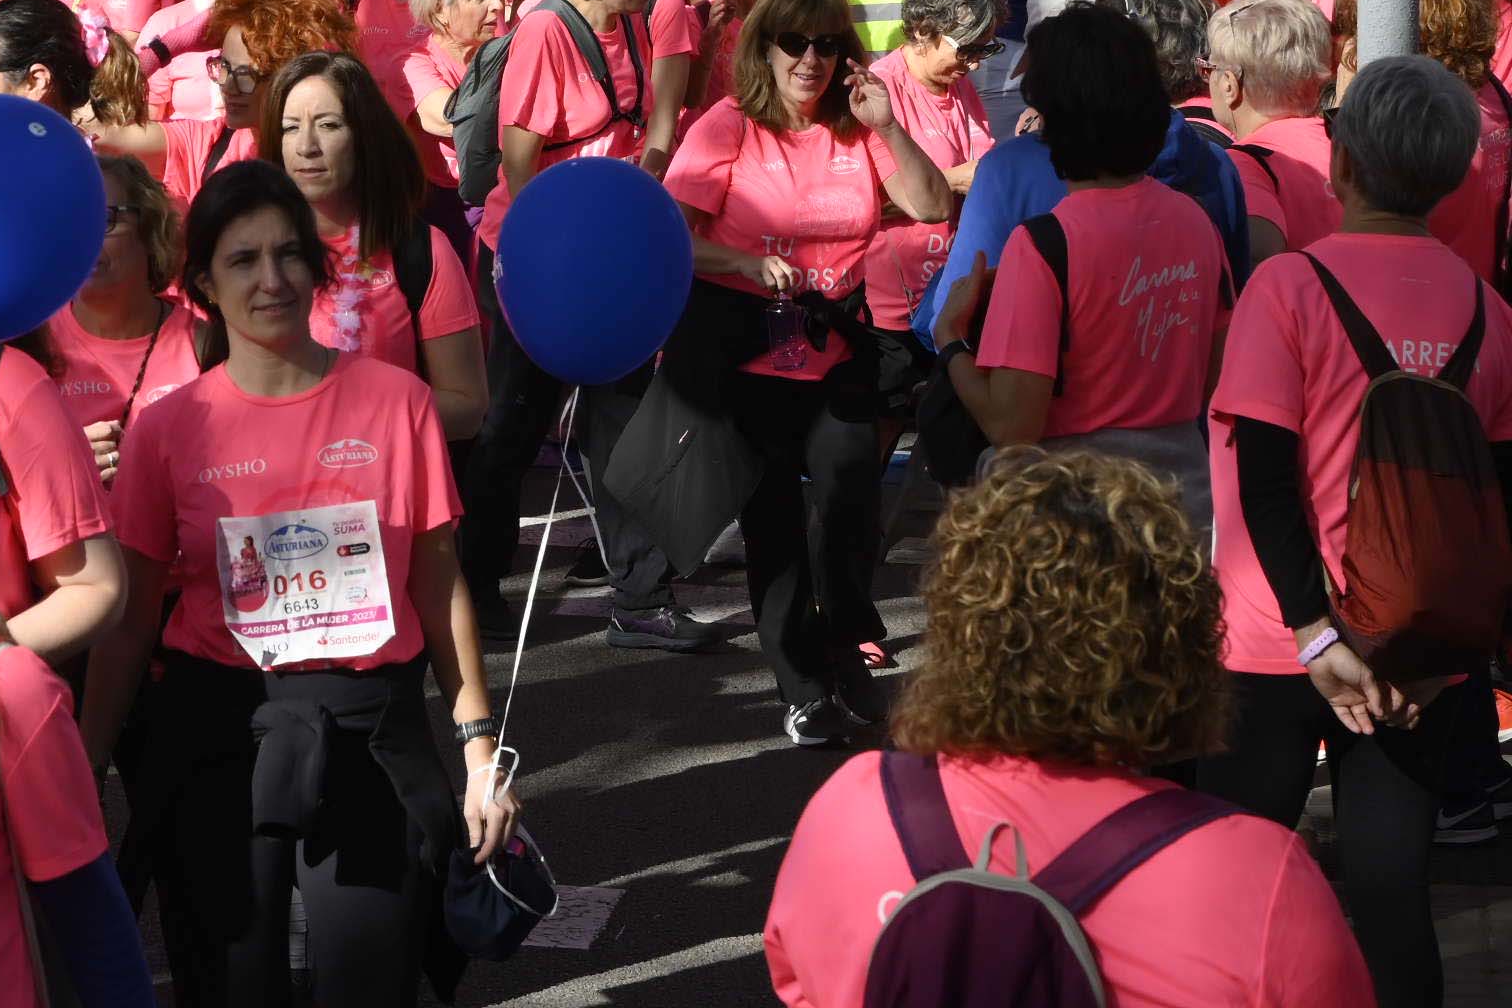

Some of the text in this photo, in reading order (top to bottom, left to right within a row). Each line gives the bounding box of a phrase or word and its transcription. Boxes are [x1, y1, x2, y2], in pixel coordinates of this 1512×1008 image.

[1386, 338, 1457, 369] ARRE
[322, 449, 375, 464] ASTURIANA
[199, 458, 267, 484] OYSHO
[334, 523, 366, 536] SUMA
[268, 539, 324, 554] ASTURIANA
[273, 569, 328, 596] 016
[241, 623, 285, 636] CARRERA
[302, 617, 315, 628] LA
[316, 613, 348, 626] MUJER
[329, 631, 380, 646] Santander
